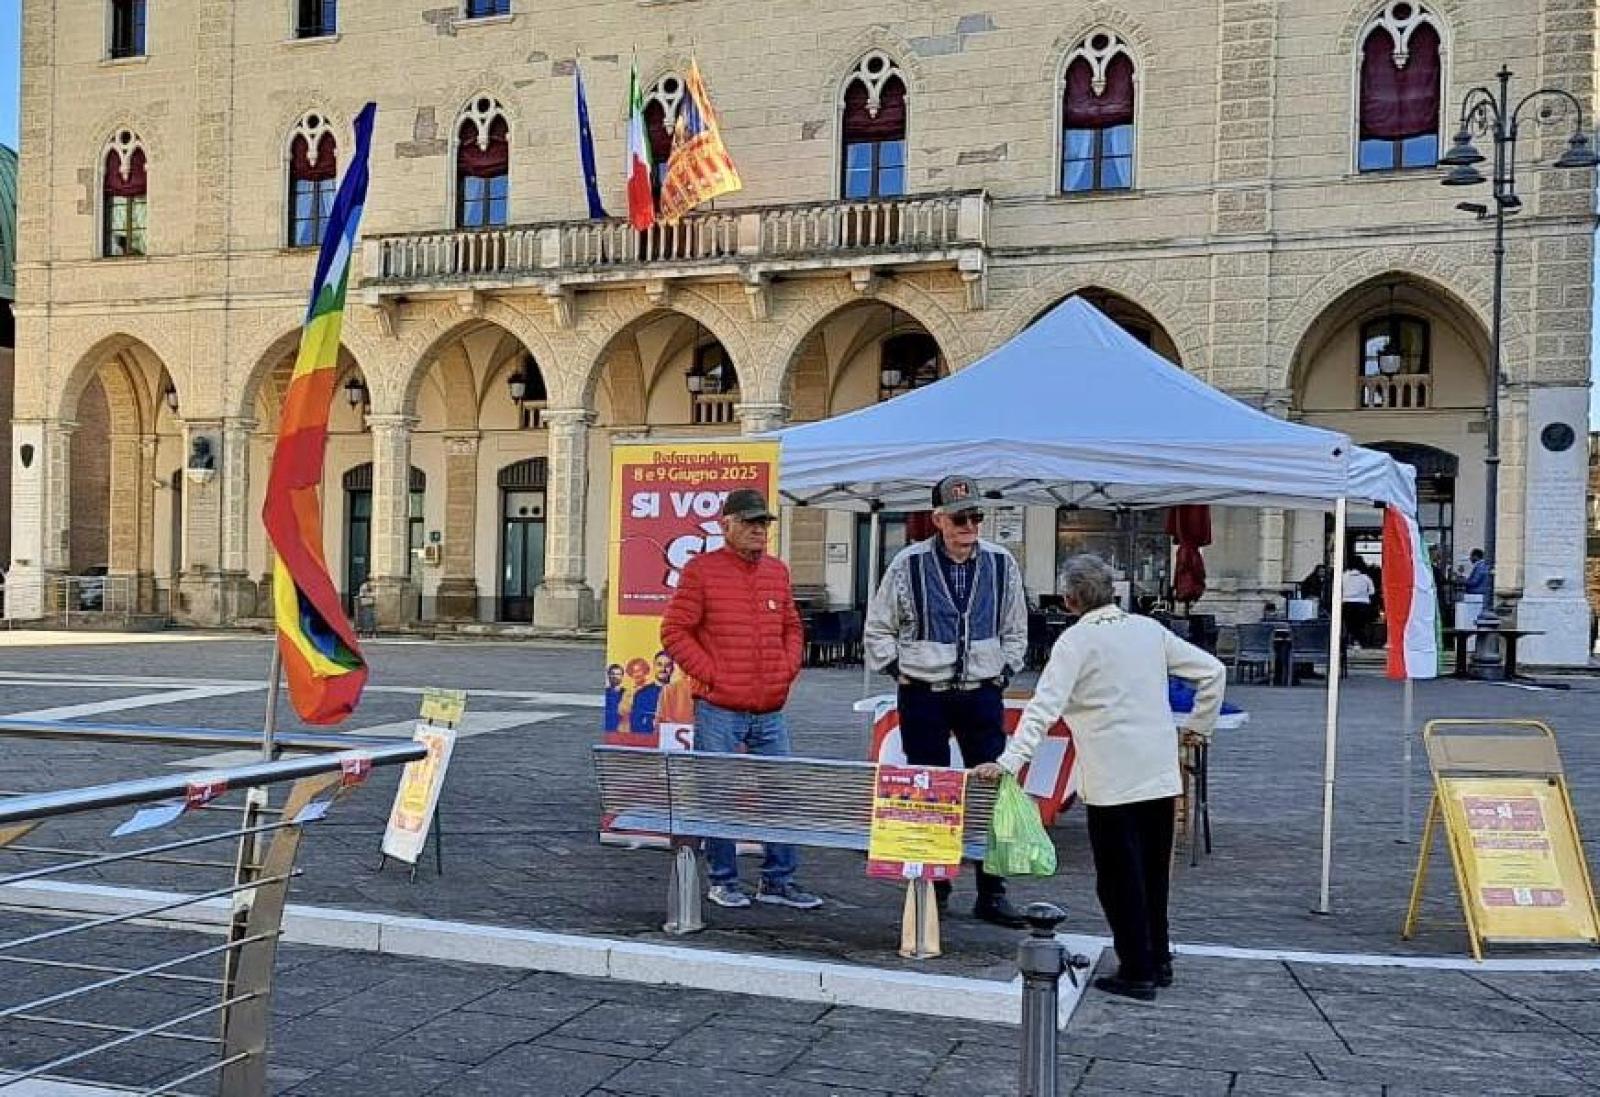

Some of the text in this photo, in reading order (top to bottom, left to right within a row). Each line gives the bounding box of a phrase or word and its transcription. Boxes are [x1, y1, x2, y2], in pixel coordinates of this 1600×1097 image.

[645, 470, 655, 481] e
[667, 467, 718, 485] Giugno
[720, 466, 758, 480] 2025
[631, 491, 661, 518] SI
